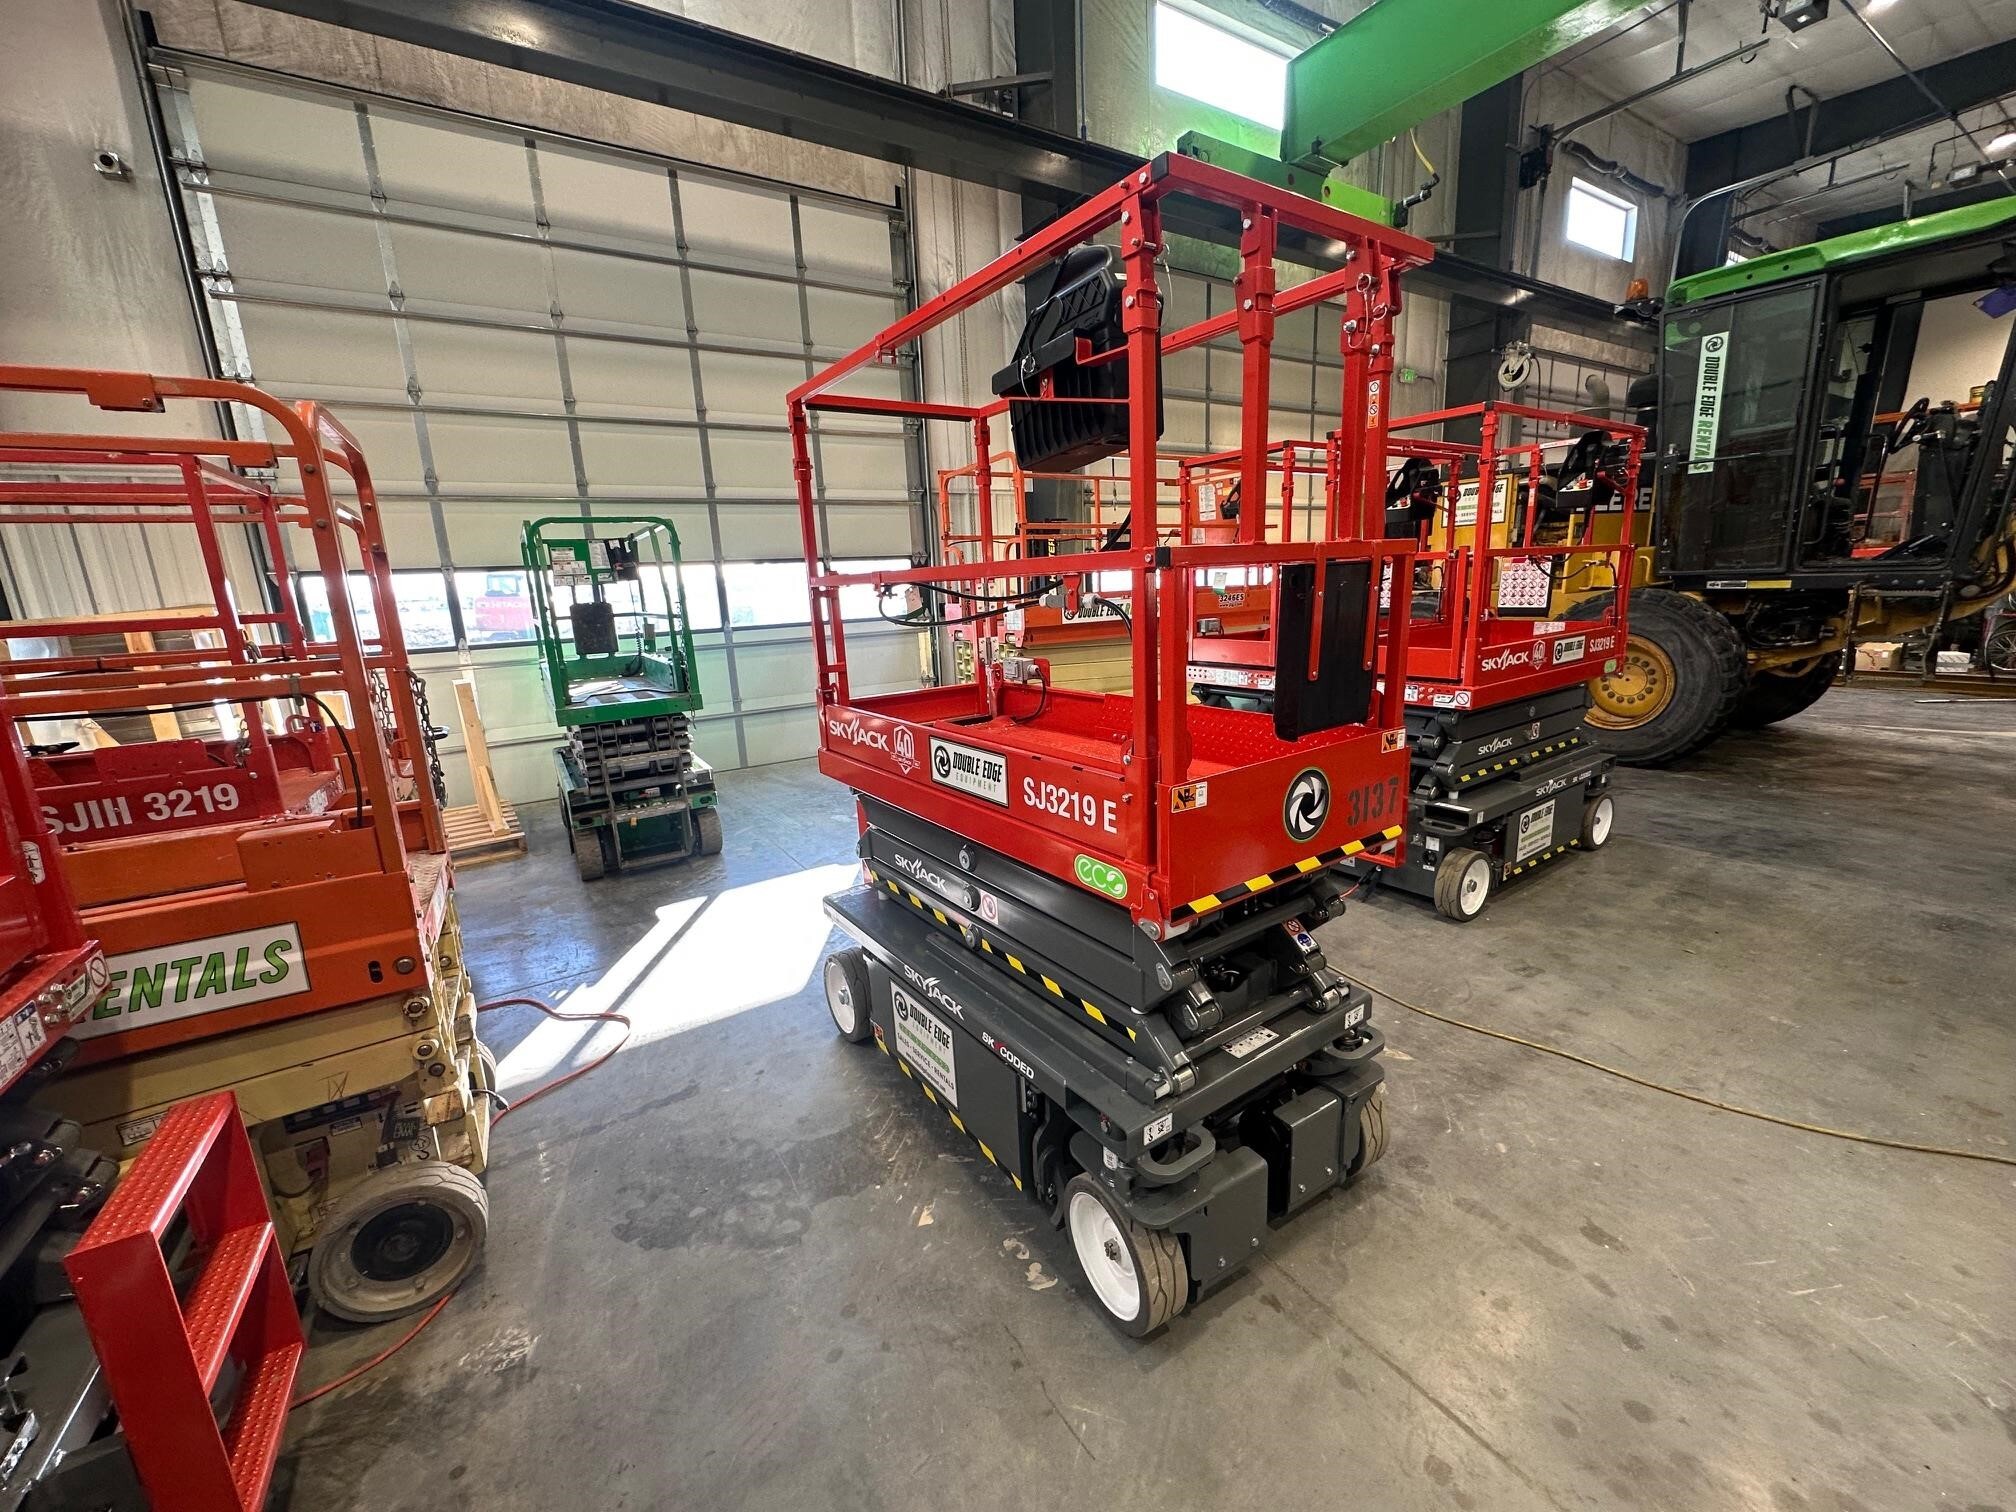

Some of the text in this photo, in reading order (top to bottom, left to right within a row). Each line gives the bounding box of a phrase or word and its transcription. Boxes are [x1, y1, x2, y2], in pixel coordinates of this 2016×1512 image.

[1693, 356, 1720, 471] DOUBLE EDGE RENTAS
[1481, 648, 1529, 672] SKYJACK
[828, 717, 890, 752] SKYJACK
[896, 730, 912, 759] 40
[1478, 737, 1513, 756] SKYJACK
[952, 751, 1003, 783] DOUBLE EDGE
[955, 772, 997, 793] EQUIPMENT
[143, 783, 240, 822] 3219
[1023, 776, 1118, 834] SJ3219 E
[1347, 775, 1400, 827] 3137
[1535, 777, 1567, 798] SKYJACK
[894, 853, 948, 893] SKYJACK
[91, 938, 293, 1022] ENTALS
[903, 964, 965, 1021] SKYJACK
[909, 1003, 933, 1034] DOUBLE
[933, 1023, 951, 1050] EDGE
[934, 1066, 955, 1091] RENTALS
